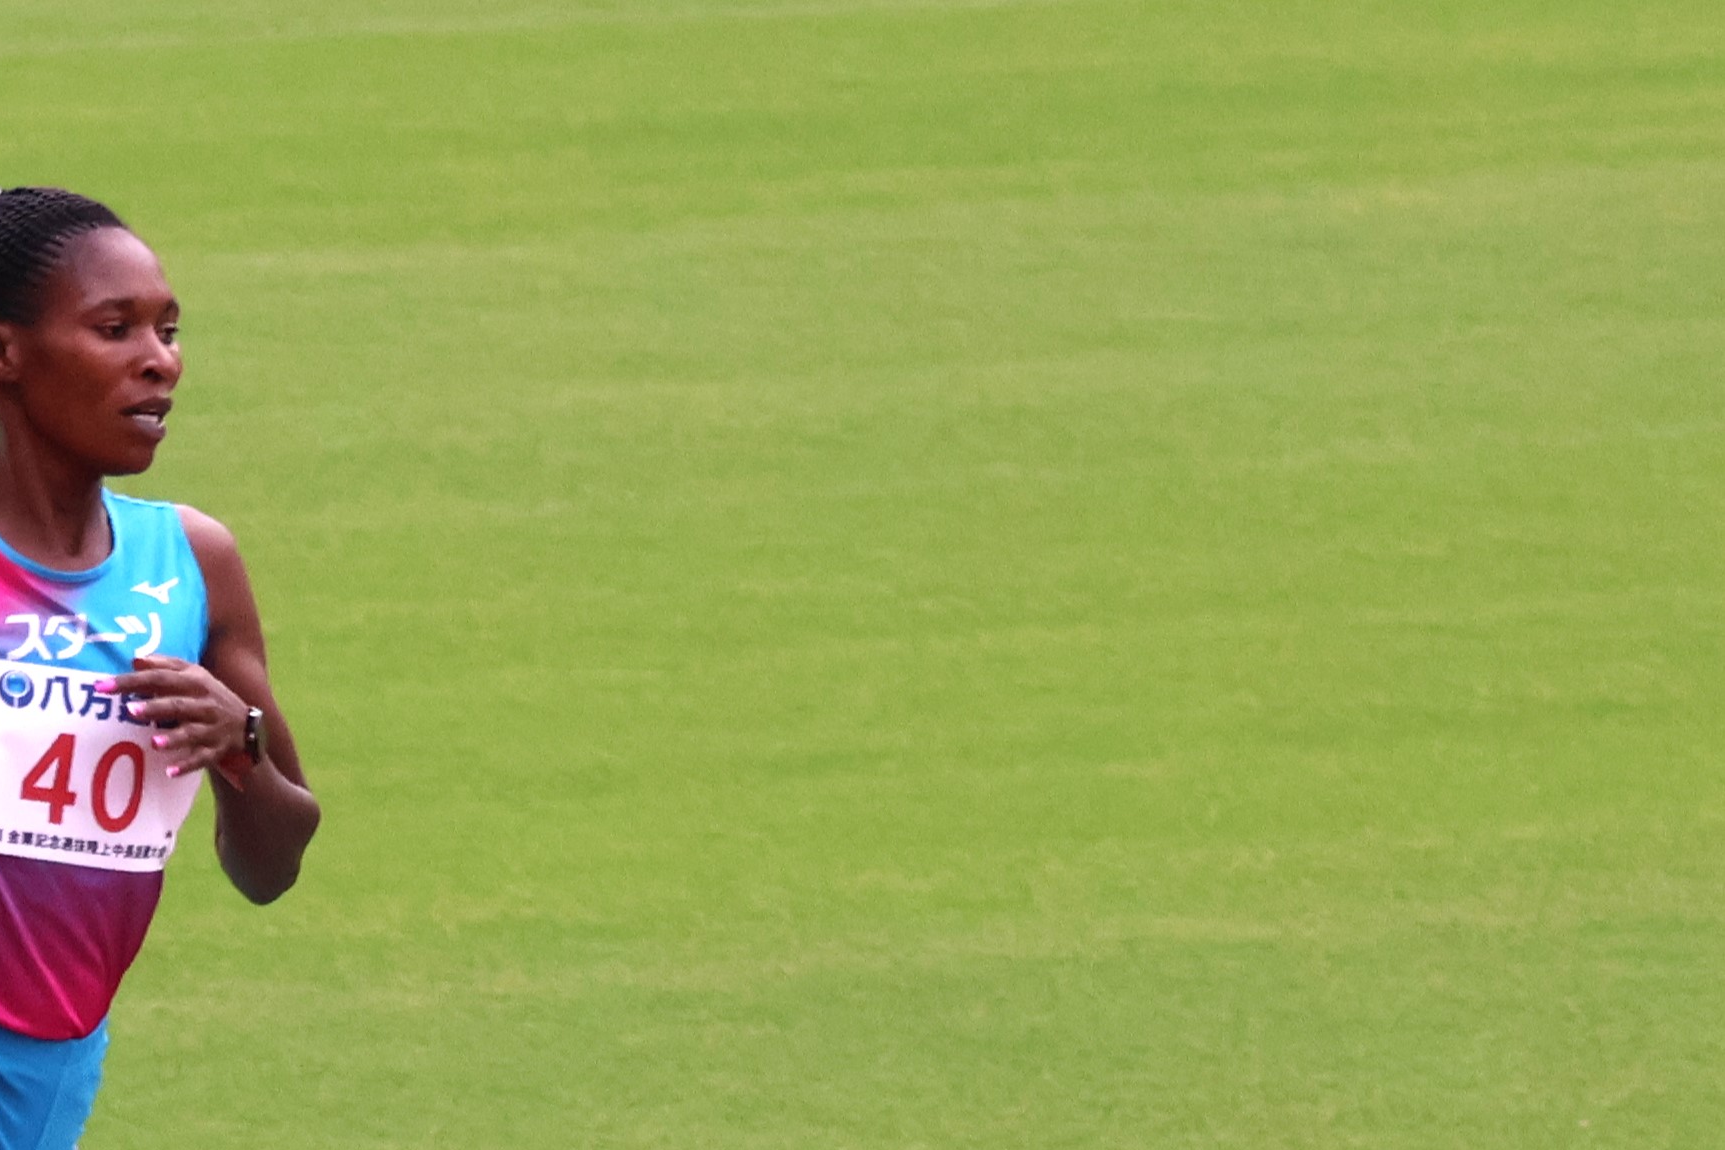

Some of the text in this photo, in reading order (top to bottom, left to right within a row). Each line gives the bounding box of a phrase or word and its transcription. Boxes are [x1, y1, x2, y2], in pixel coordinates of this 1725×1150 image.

[5, 612, 162, 660] スターツ
[20, 733, 145, 833] 40
